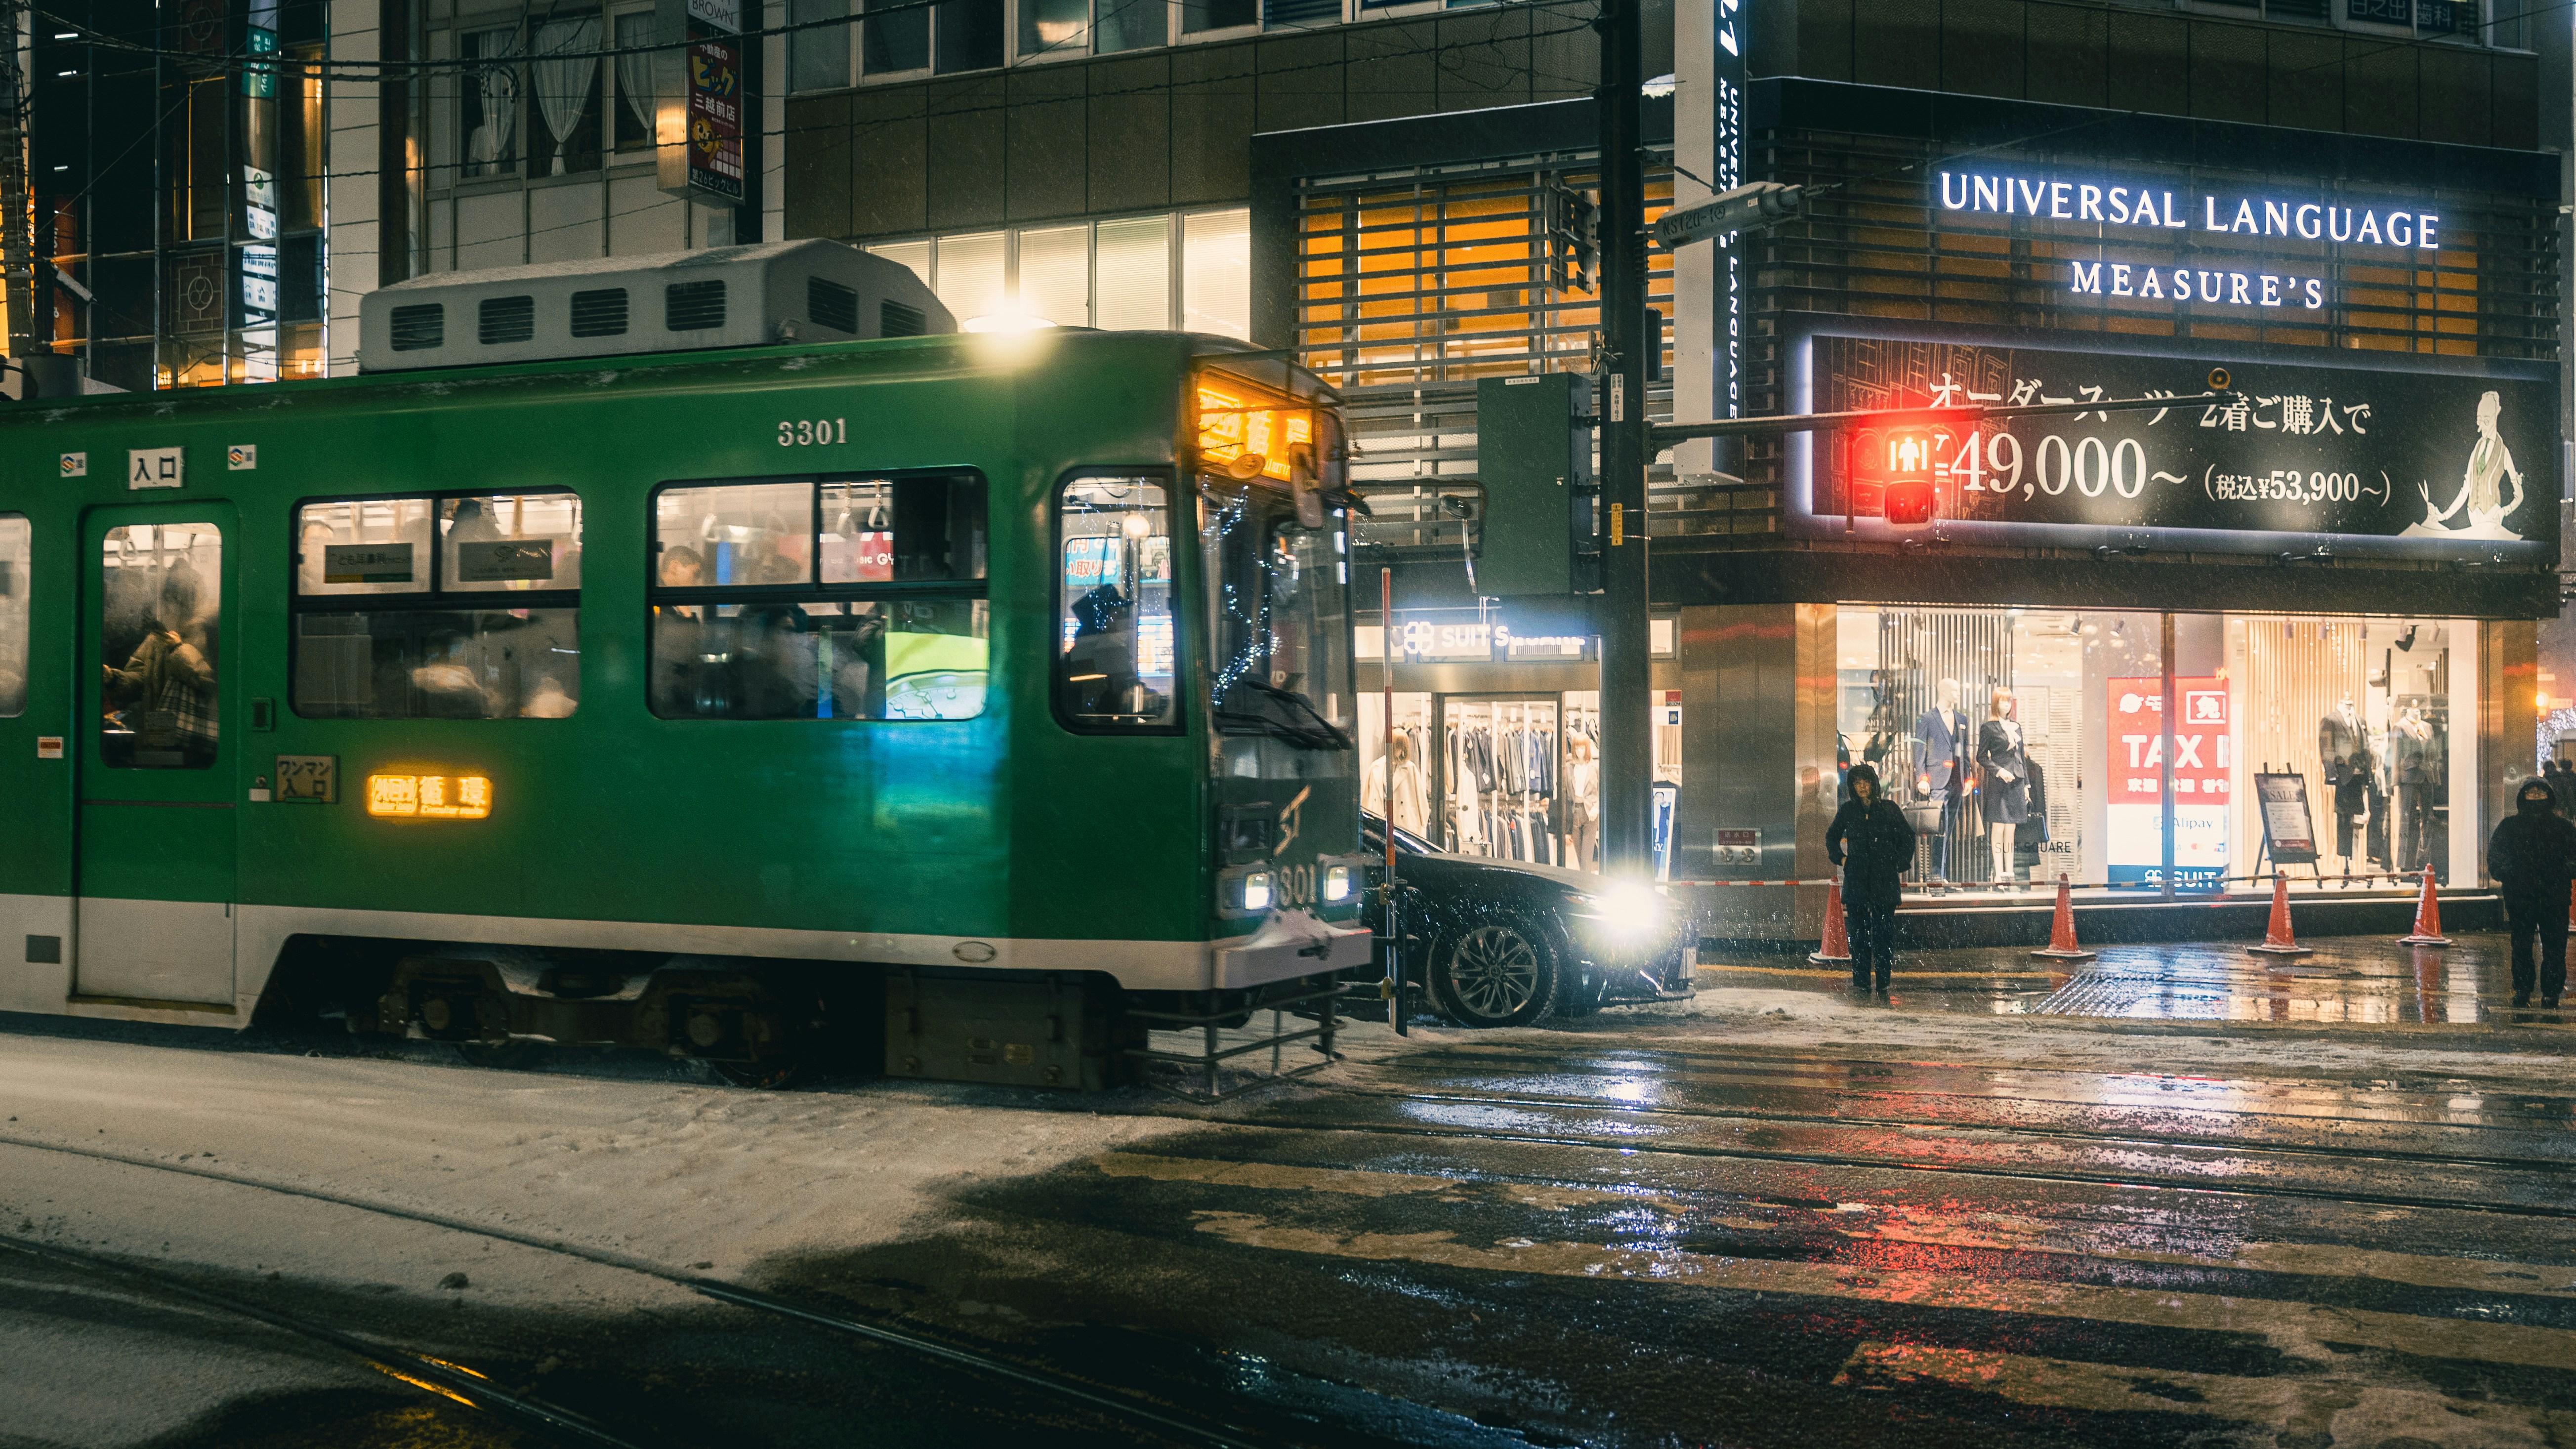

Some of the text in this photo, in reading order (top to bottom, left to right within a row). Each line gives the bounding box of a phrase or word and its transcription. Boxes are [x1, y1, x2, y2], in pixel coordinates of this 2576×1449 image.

[693, 0, 733, 25] BROWN
[692, 55, 737, 97] ビッグ
[695, 92, 735, 122] 三越前店
[692, 168, 738, 194] 第26ビッグビル
[1940, 172, 2439, 249] UNIVERSAL LANGUAGE
[2072, 261, 2323, 309] MEASURE'S
[1730, 256, 1738, 419] LANGUAGE
[1929, 373, 2174, 426] オーダースツ
[777, 418, 848, 447] 3301
[133, 456, 176, 481] 入口
[1442, 626, 1491, 648] SUIT
[2121, 734, 2204, 768] TAX
[279, 760, 332, 776] ワンマン
[283, 778, 326, 796] 入口
[2269, 790, 2296, 800] SALE
[2174, 817, 2213, 829] Alipay
